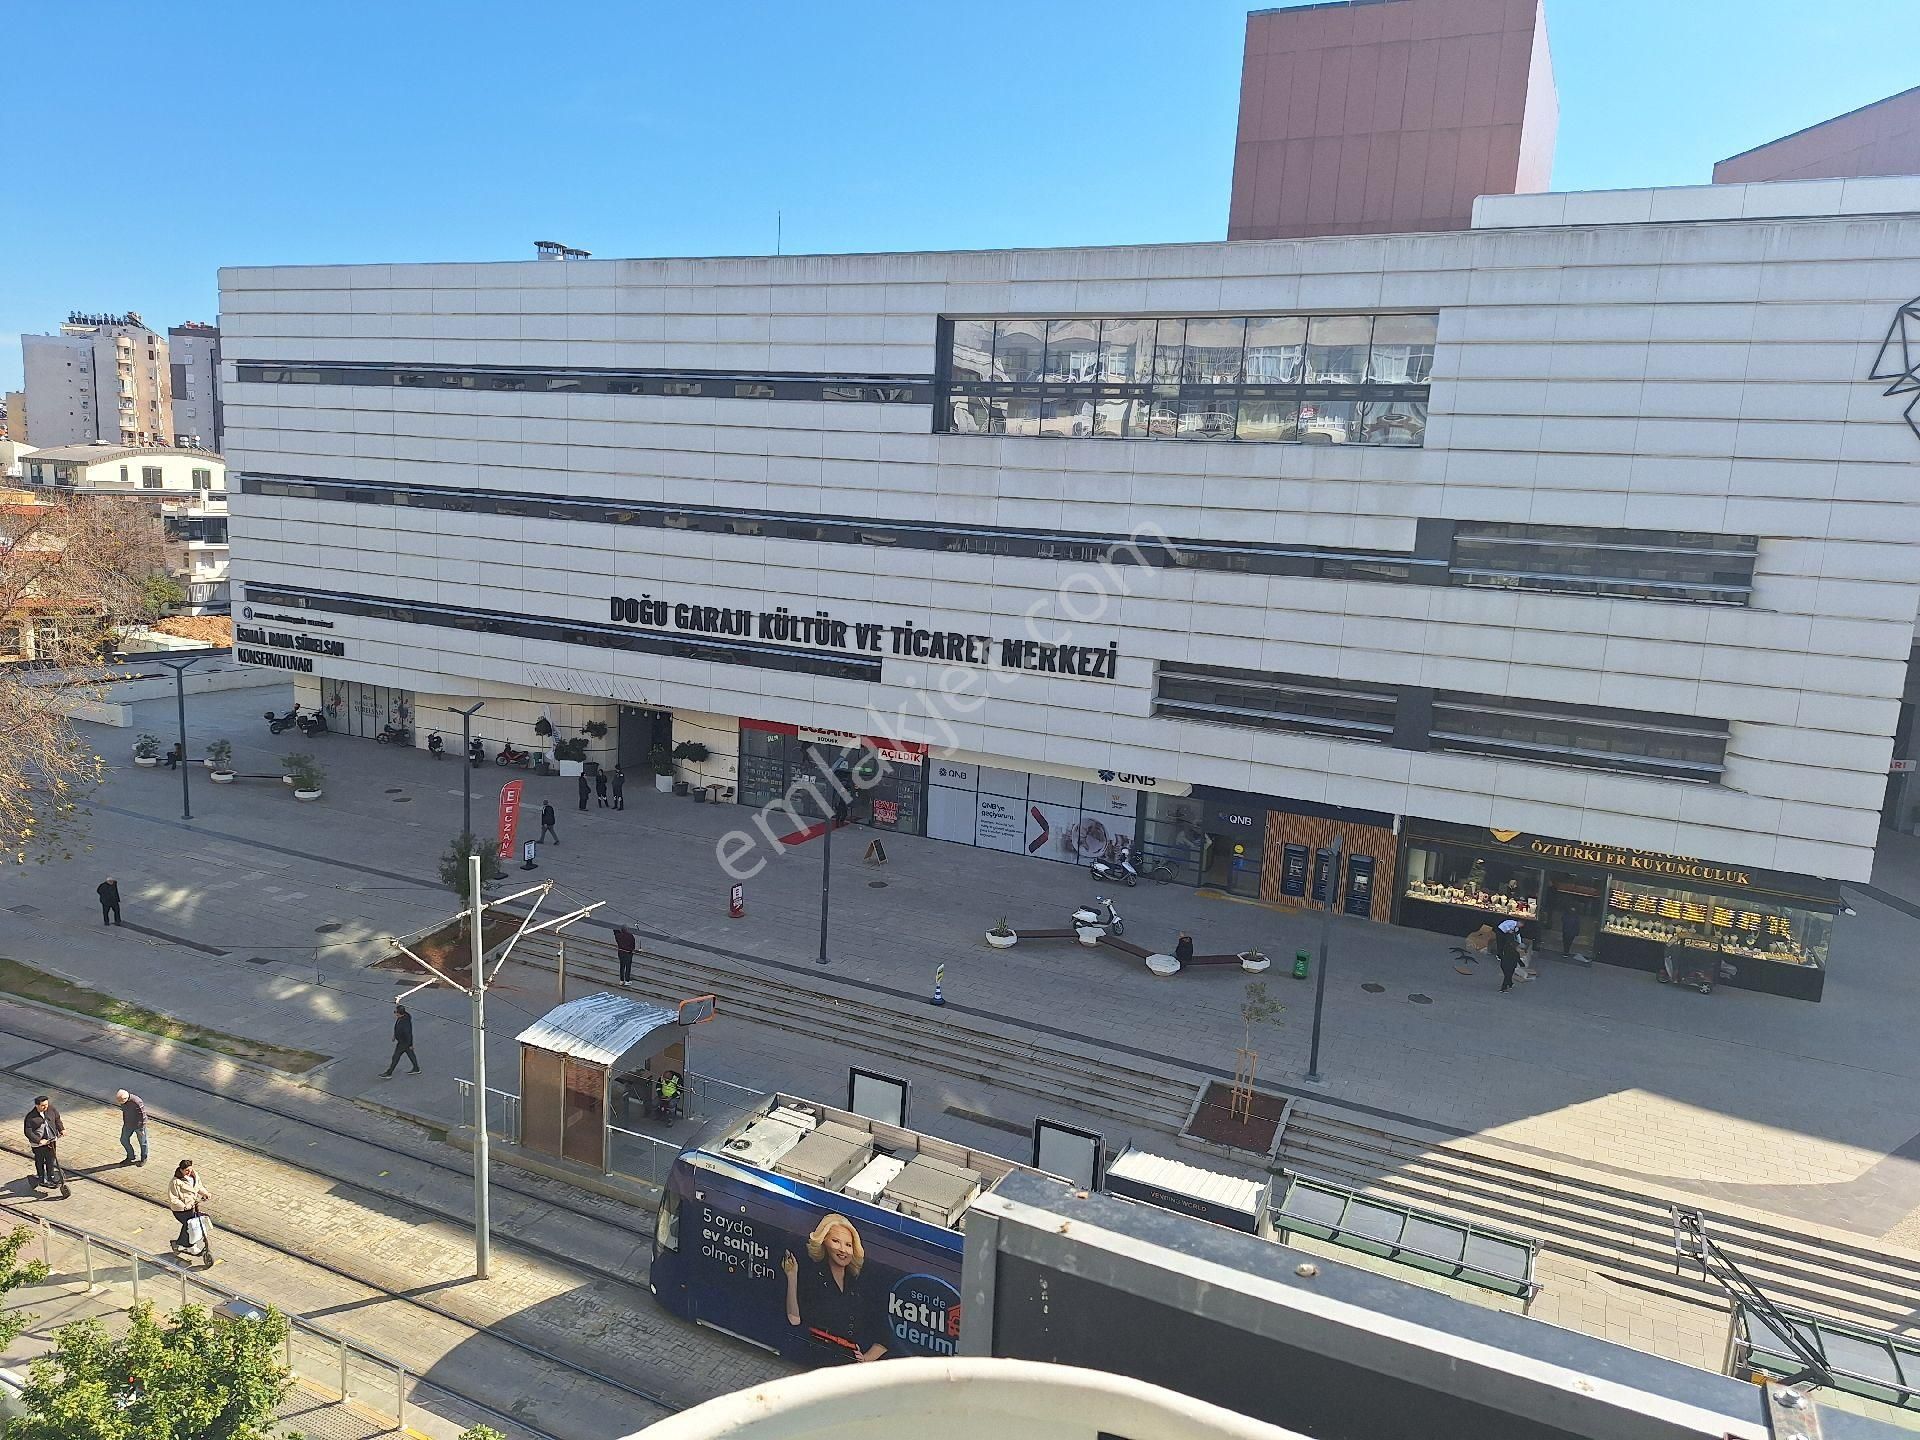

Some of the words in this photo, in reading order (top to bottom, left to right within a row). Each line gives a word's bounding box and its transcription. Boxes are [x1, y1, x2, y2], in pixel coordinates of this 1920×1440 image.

[236, 623, 269, 646] İSMAİL
[610, 593, 668, 627] DOĞU
[675, 602, 751, 636] GARAJI
[759, 607, 847, 649] KÜLTÜR
[855, 622, 884, 652] VE
[890, 620, 994, 665] TİCARET
[1001, 639, 1118, 680] MERKEZİ
[237, 647, 313, 673] KONSERVATUVARI
[948, 769, 967, 780] QNB
[1117, 771, 1156, 786] QNB
[1229, 814, 1252, 826] QNB
[1630, 860, 1750, 885] KUYUMCULUK
[702, 1207, 712, 1223] 5
[715, 1215, 753, 1238] ayda
[702, 1228, 720, 1242] ev
[723, 1236, 769, 1260] sahibi
[749, 1258, 775, 1280] için
[910, 1290, 930, 1304] sen
[932, 1295, 946, 1309] de
[888, 1292, 945, 1333] katıl
